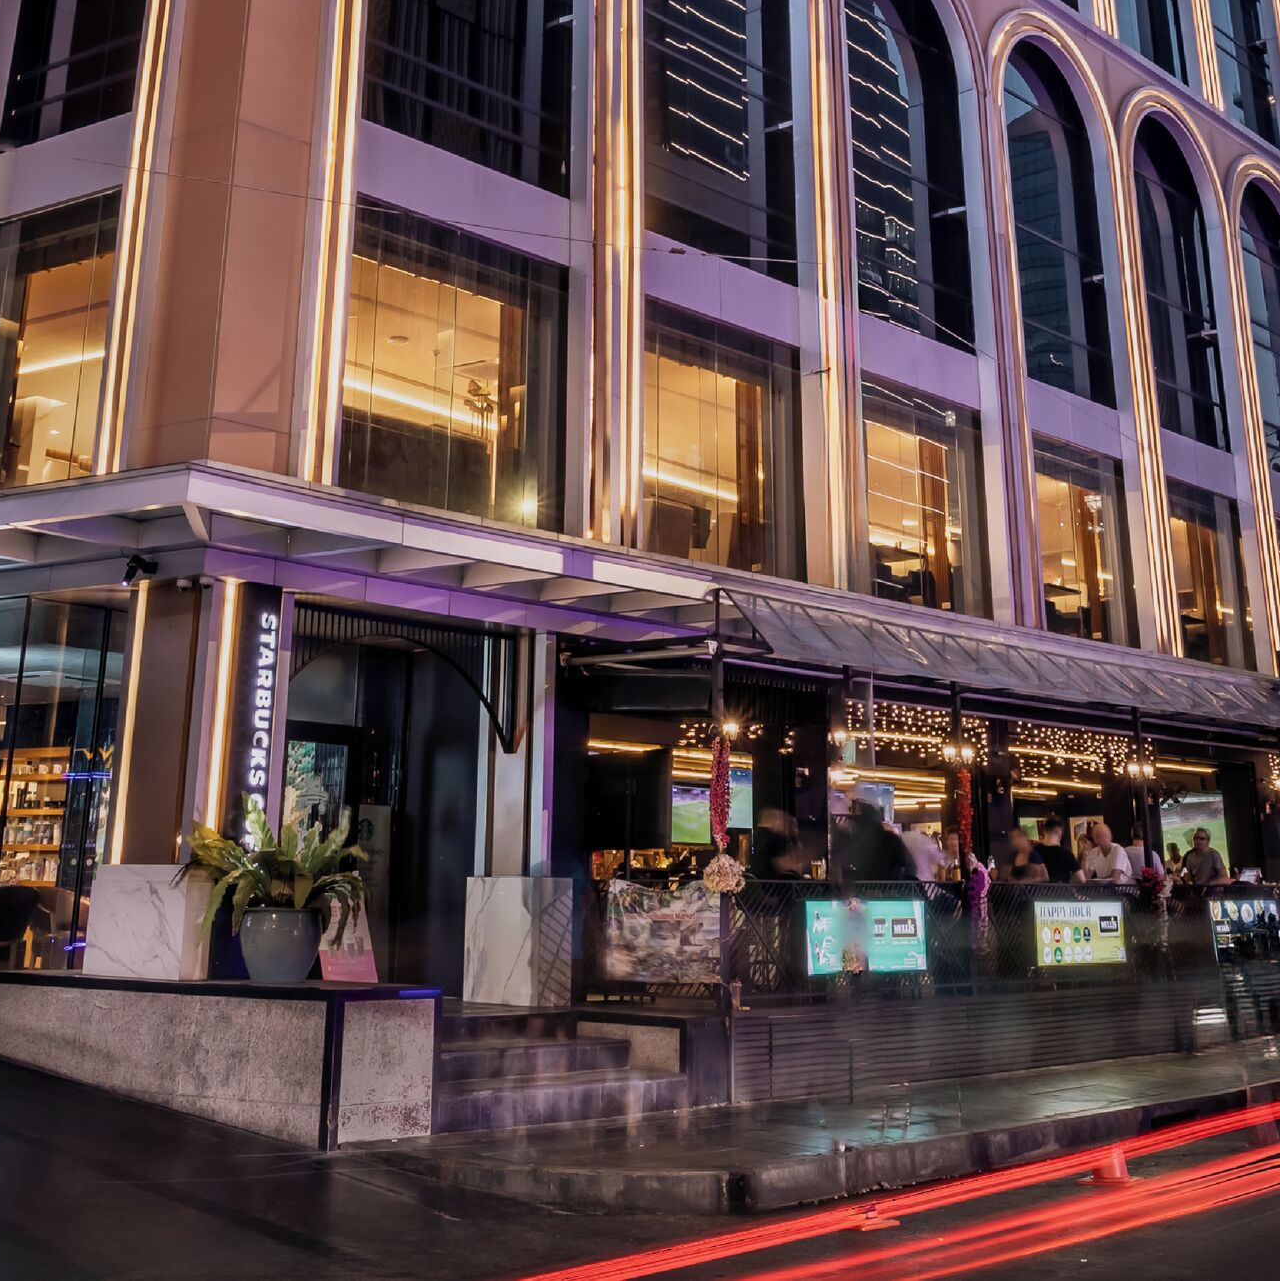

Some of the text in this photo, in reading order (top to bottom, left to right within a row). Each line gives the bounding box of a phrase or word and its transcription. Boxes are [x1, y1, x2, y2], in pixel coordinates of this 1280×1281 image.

[247, 611, 278, 788] STARBUCKS
[1040, 905, 1092, 918] HAPPY HOUR
